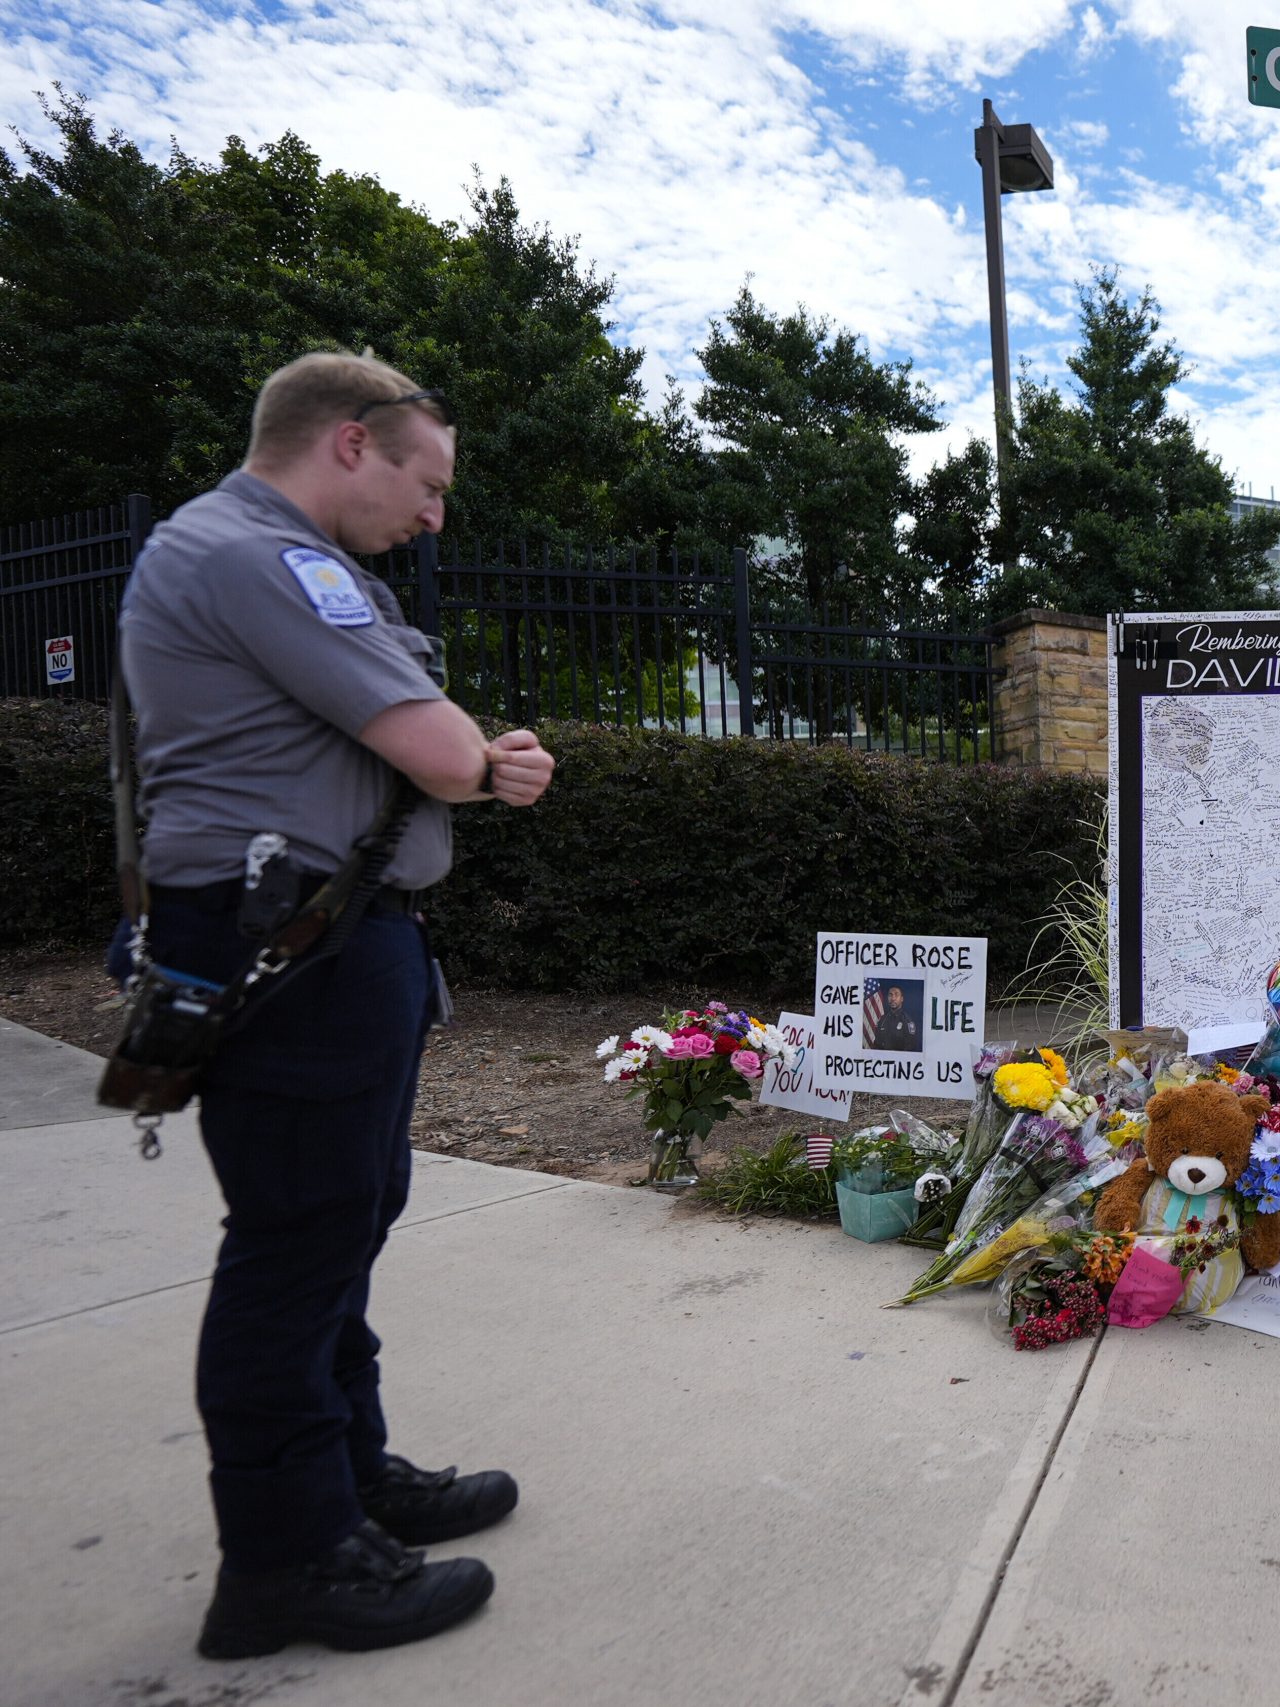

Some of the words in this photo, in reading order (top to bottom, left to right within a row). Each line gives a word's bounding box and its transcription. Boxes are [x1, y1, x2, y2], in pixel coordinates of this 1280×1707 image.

[52, 653, 68, 669] NO
[821, 940, 899, 967] OFFICER
[912, 943, 973, 970] ROSE
[820, 985, 861, 1007] GAVE
[823, 1014, 854, 1038] HIS
[930, 996, 975, 1034] LIFE
[770, 1061, 804, 1094] YOU
[825, 1055, 925, 1081] PROTECTING
[937, 1061, 963, 1084] US
